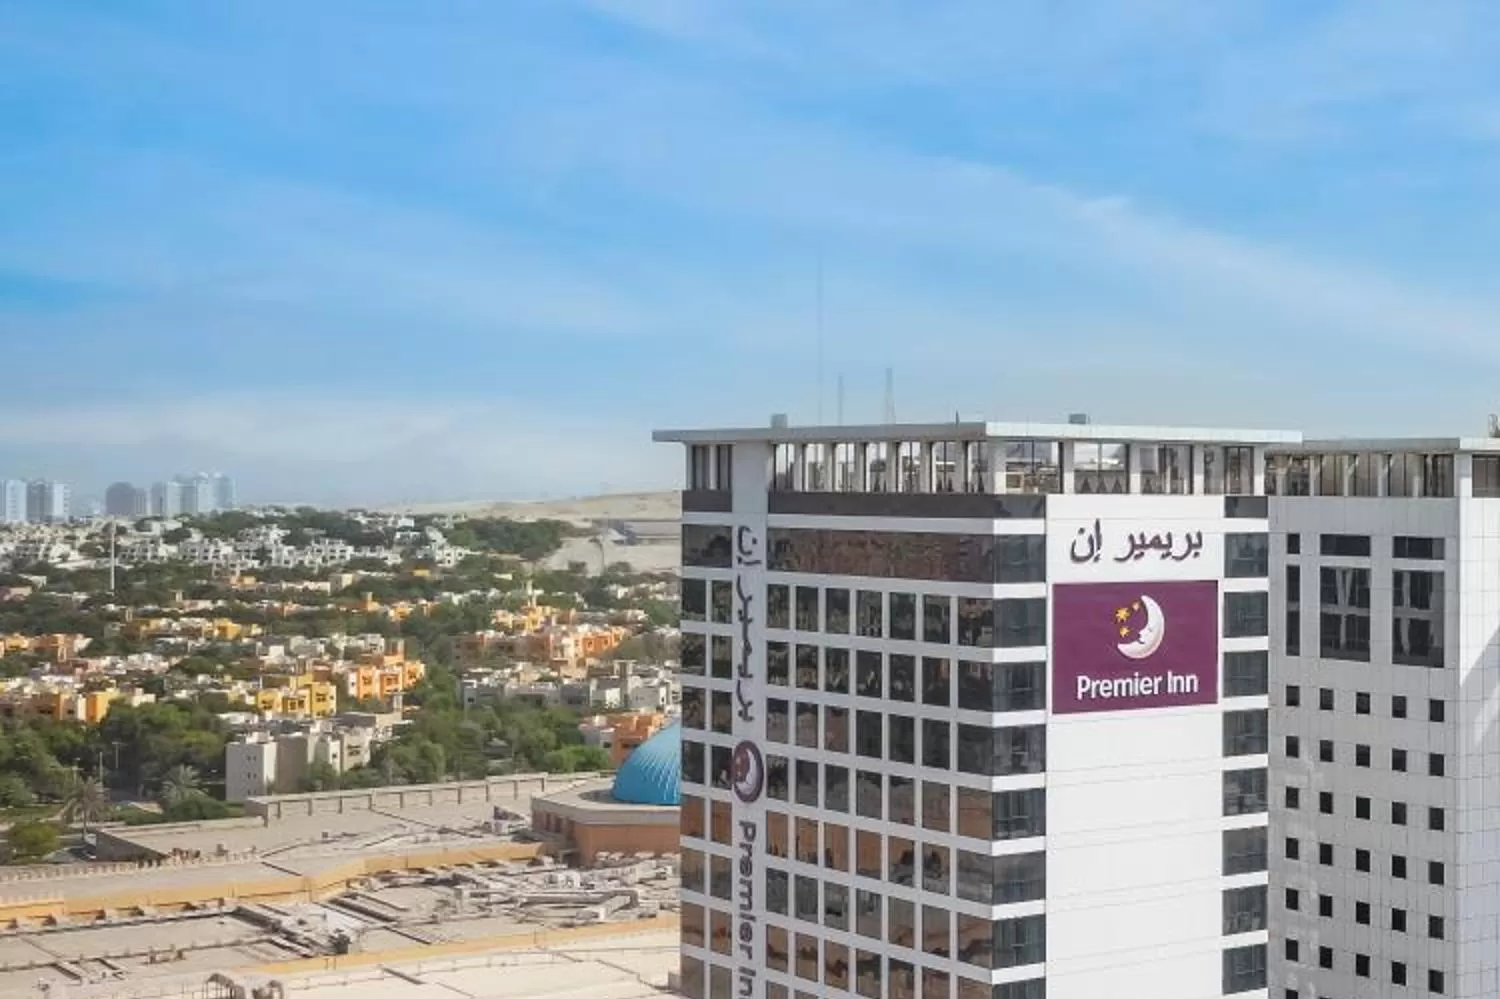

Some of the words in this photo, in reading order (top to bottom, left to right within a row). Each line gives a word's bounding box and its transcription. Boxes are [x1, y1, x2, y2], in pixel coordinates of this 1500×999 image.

[1070, 518, 1103, 563] إن
[1114, 529, 1203, 561] بريمير
[1077, 671, 1162, 700] Premier
[1167, 670, 1199, 695] Inn
[739, 819, 757, 960] Premier
